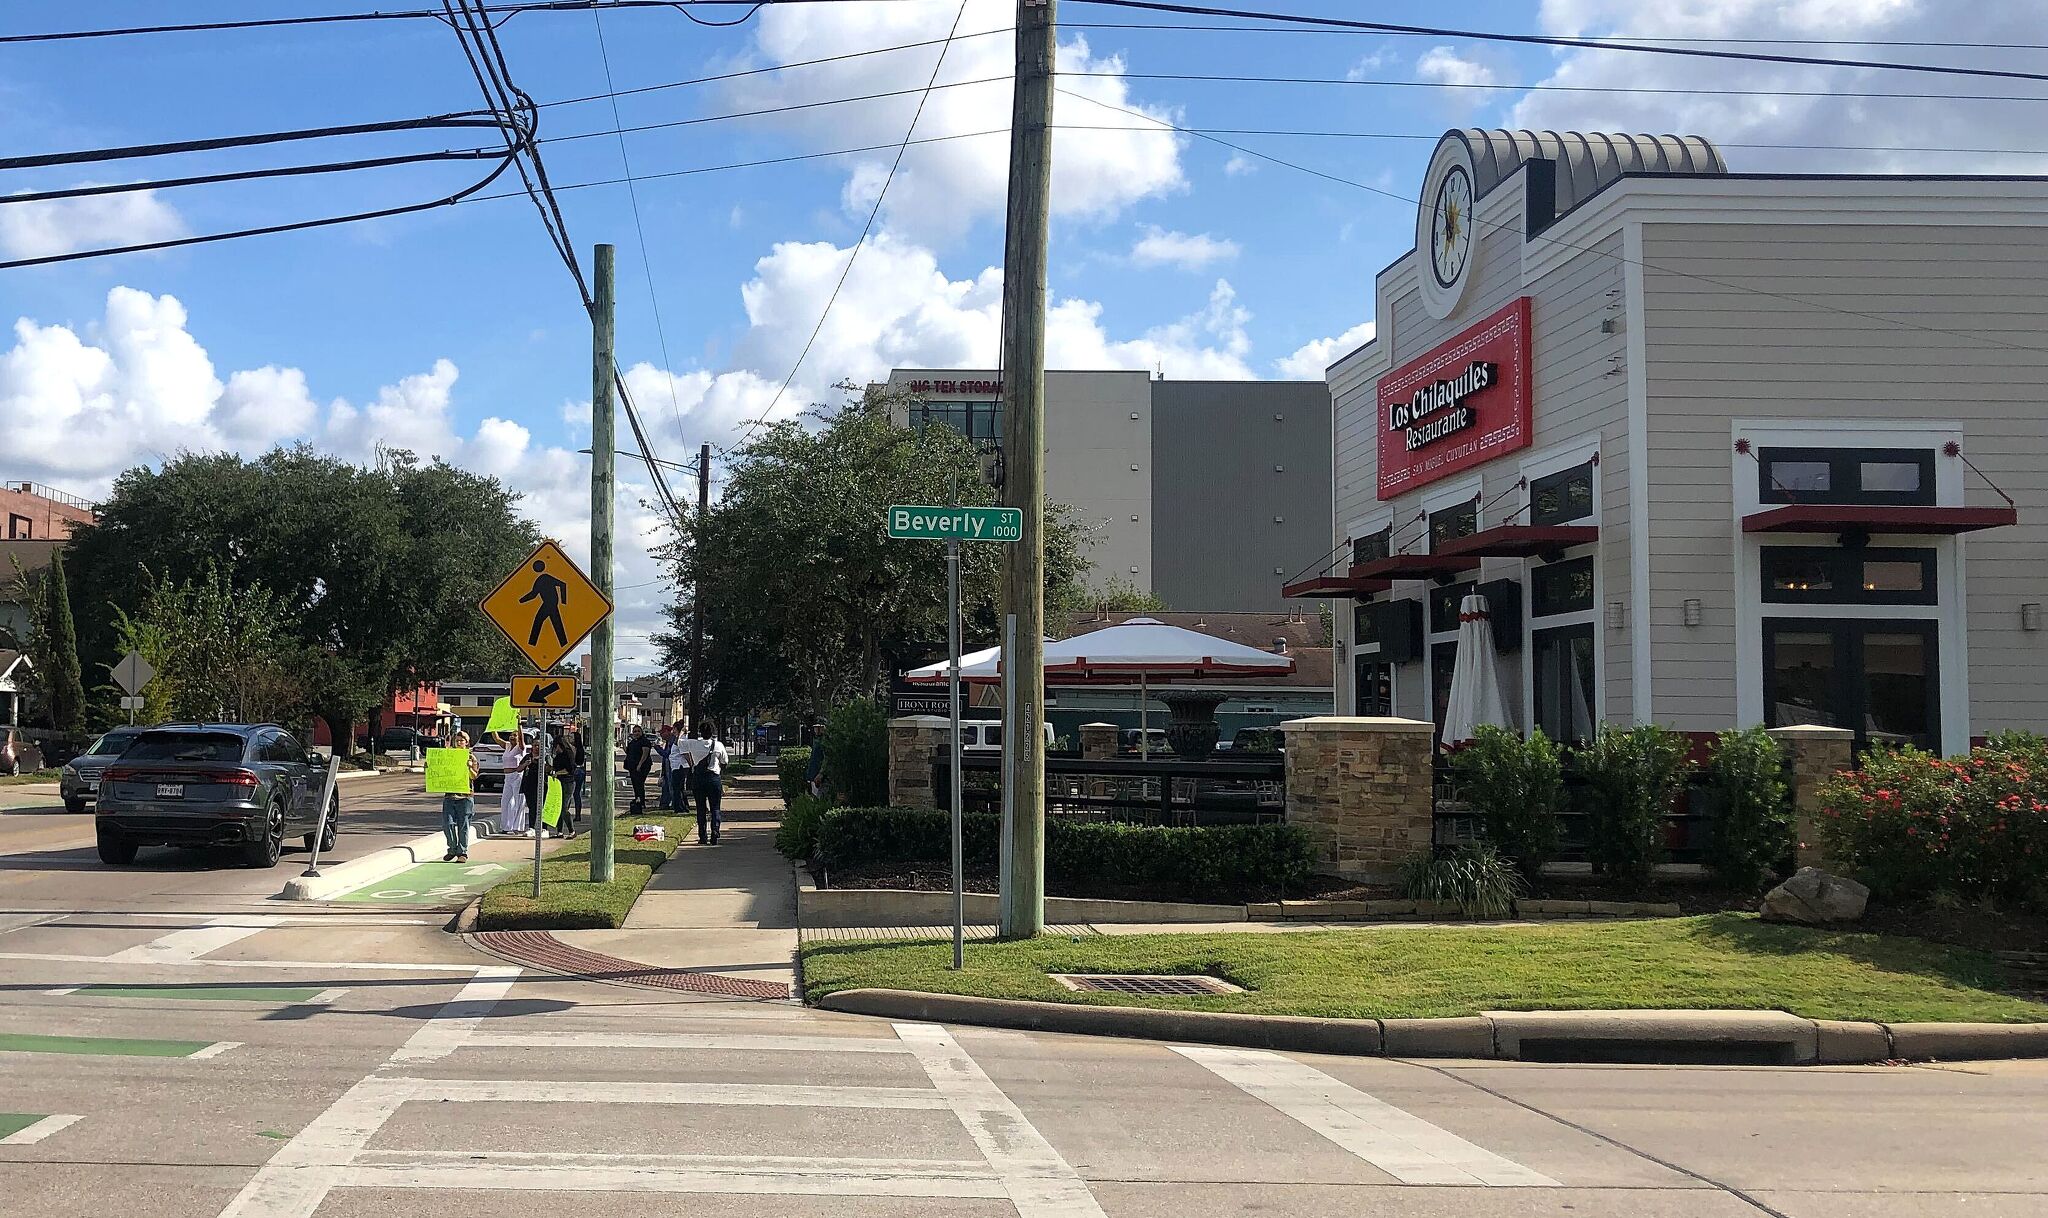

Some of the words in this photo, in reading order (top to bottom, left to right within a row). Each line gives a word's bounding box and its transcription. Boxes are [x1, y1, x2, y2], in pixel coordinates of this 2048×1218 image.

[934, 381, 957, 393] TEX
[1389, 402, 1409, 431] Los
[1412, 362, 1489, 418] Chilaquiles
[1406, 407, 1467, 451] Restaurante
[895, 511, 985, 537] Beverly
[1001, 513, 1013, 524] ST
[993, 526, 1017, 537] 1000
[931, 701, 951, 709] ROO
